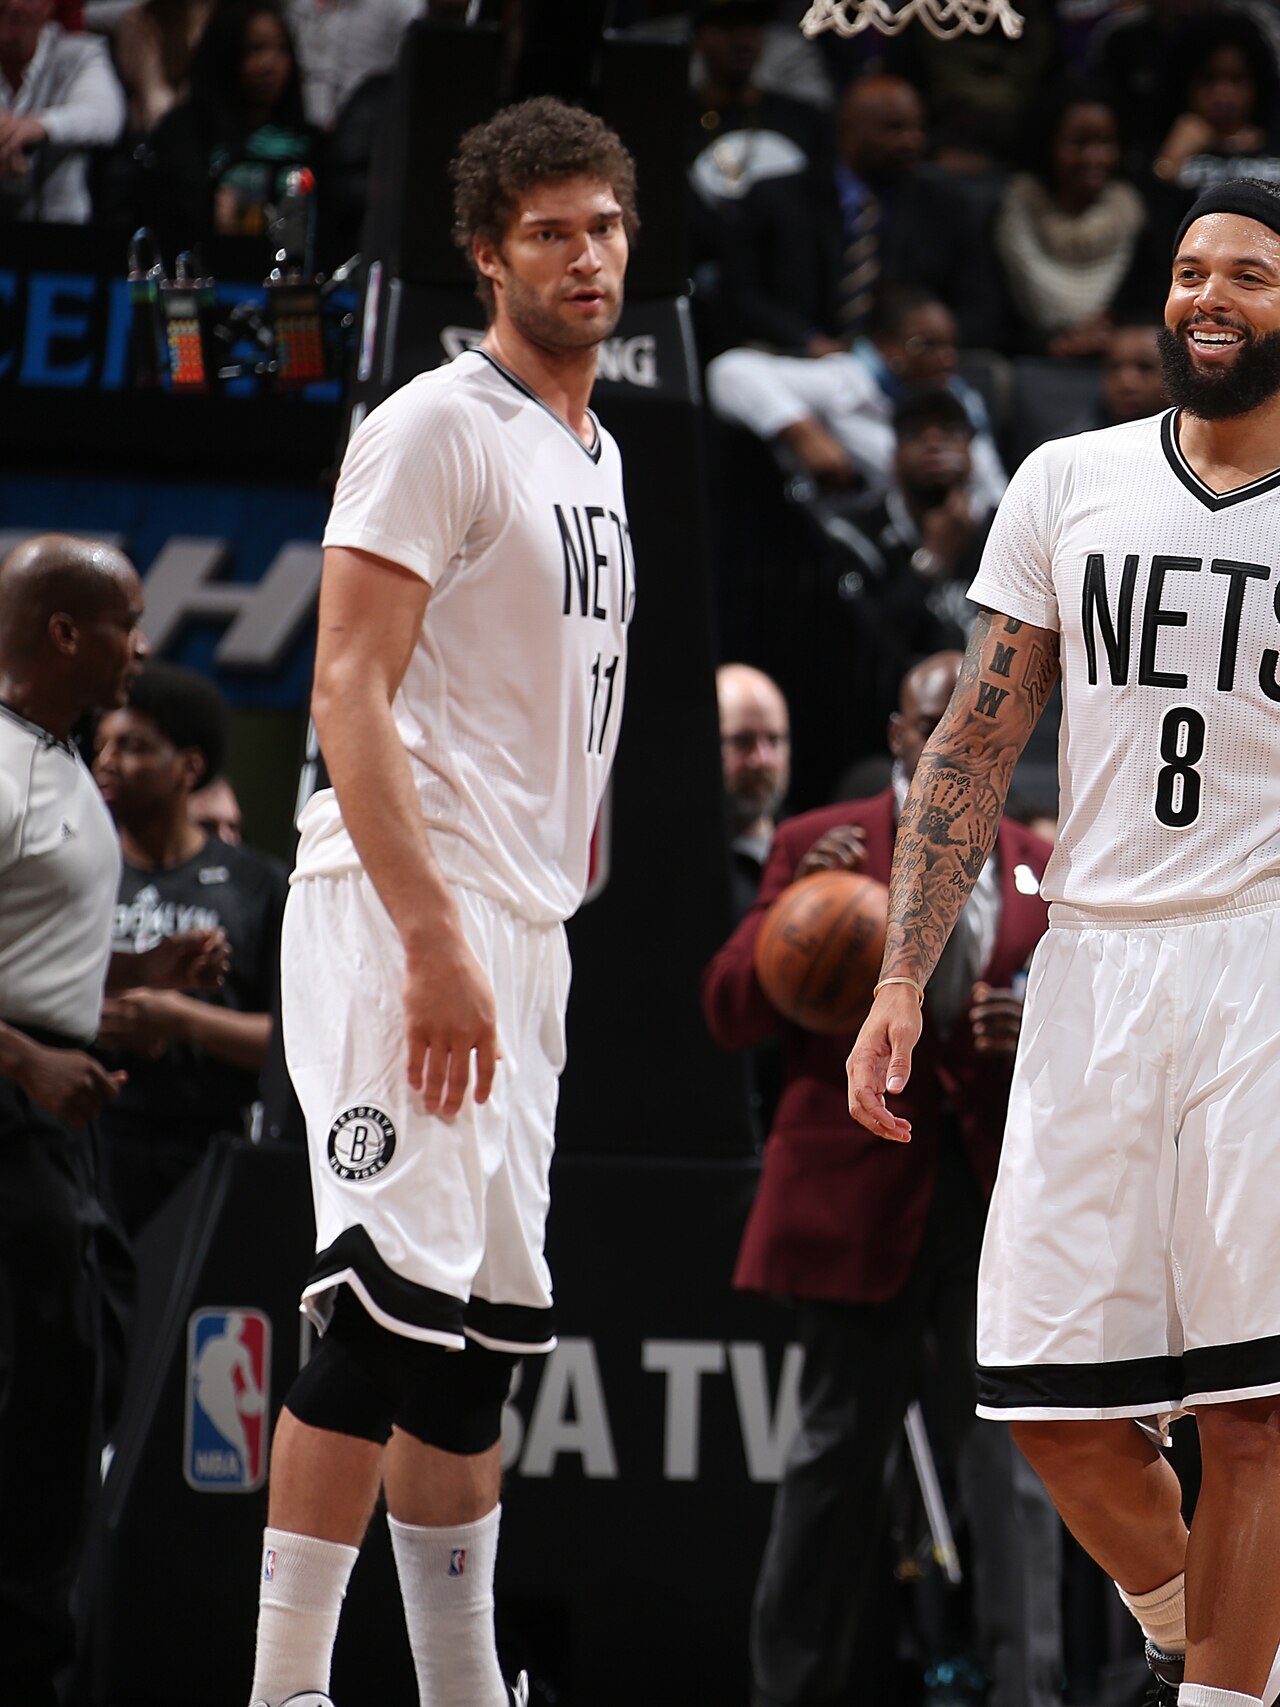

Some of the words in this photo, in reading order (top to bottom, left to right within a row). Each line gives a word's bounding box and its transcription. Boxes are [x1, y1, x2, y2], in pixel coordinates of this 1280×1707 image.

[588, 652, 619, 754] 11
[1155, 706, 1206, 828] 8
[350, 1126, 368, 1162] B
[641, 1338, 806, 1483] TV
